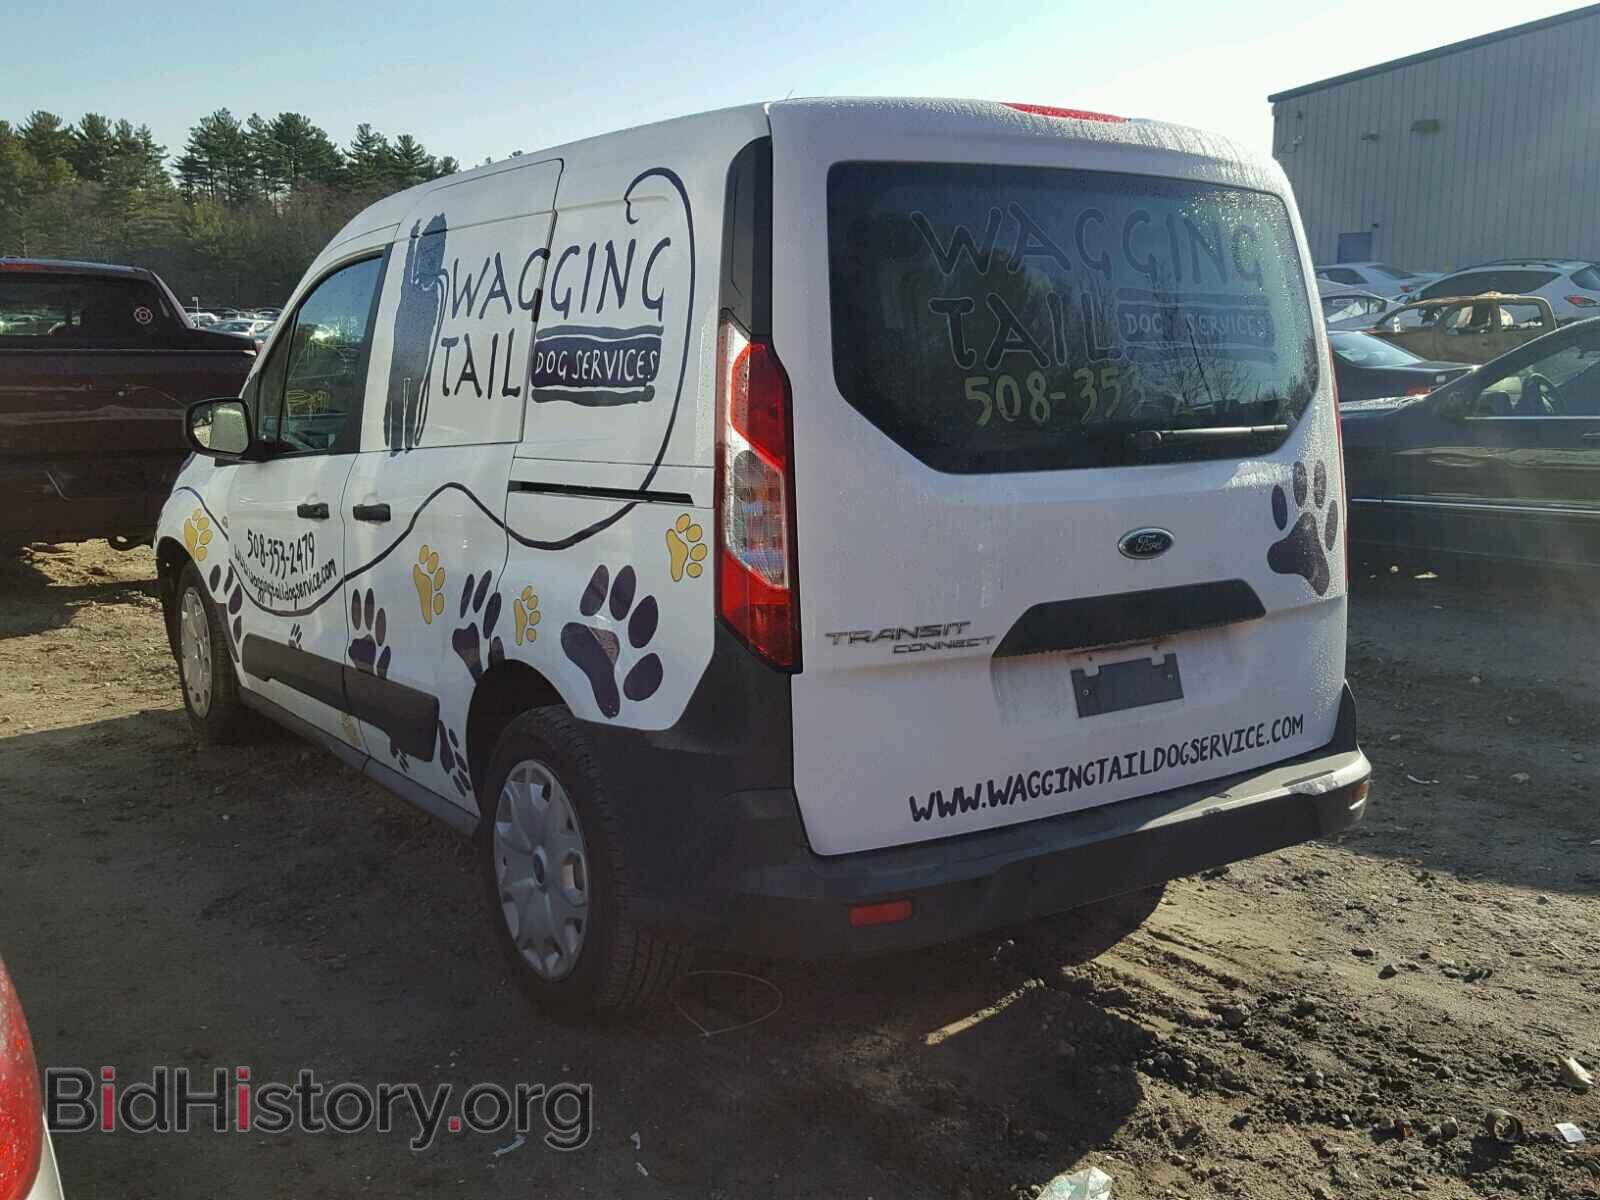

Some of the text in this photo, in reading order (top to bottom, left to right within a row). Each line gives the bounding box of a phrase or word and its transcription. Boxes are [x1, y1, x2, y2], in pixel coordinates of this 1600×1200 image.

[452, 237, 672, 322] WAGGING
[911, 201, 1264, 291] WAGGING
[441, 328, 521, 400] TAIL
[535, 348, 659, 382] DOG SERVICES
[928, 291, 1123, 370] TAIL
[247, 528, 316, 581] 508-353-2479
[825, 621, 971, 646] TRANSIT
[893, 636, 996, 654] CONNECT
[909, 713, 1304, 822] WWW.WAGGINGTAILDOGSERVICE.COM
